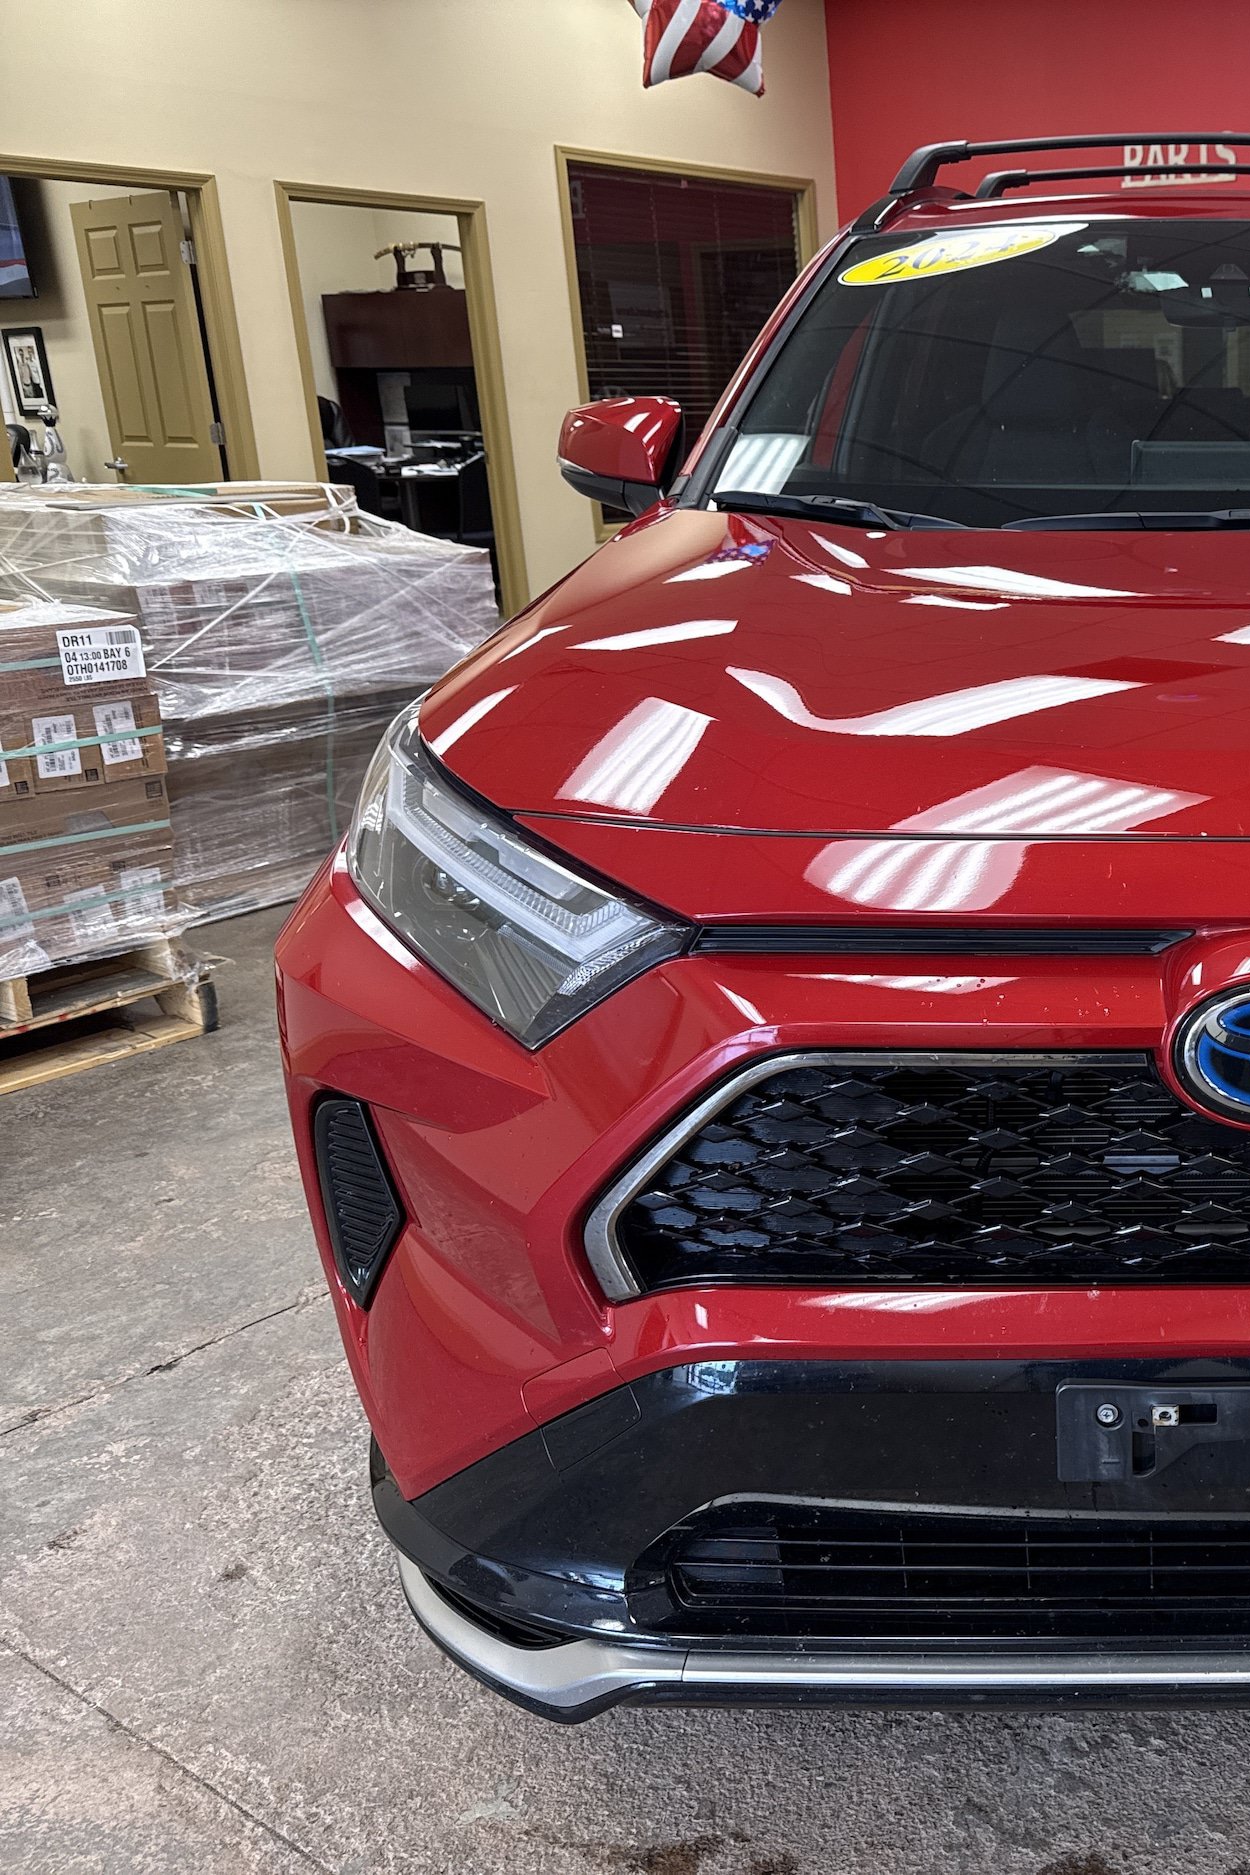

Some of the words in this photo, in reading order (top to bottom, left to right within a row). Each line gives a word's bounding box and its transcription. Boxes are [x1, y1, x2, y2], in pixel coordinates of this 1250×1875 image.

[62, 634, 92, 648] DR11
[64, 652, 78, 663] 04
[80, 651, 102, 661] 13:00
[103, 647, 122, 659] BAY
[125, 646, 131, 657] 6
